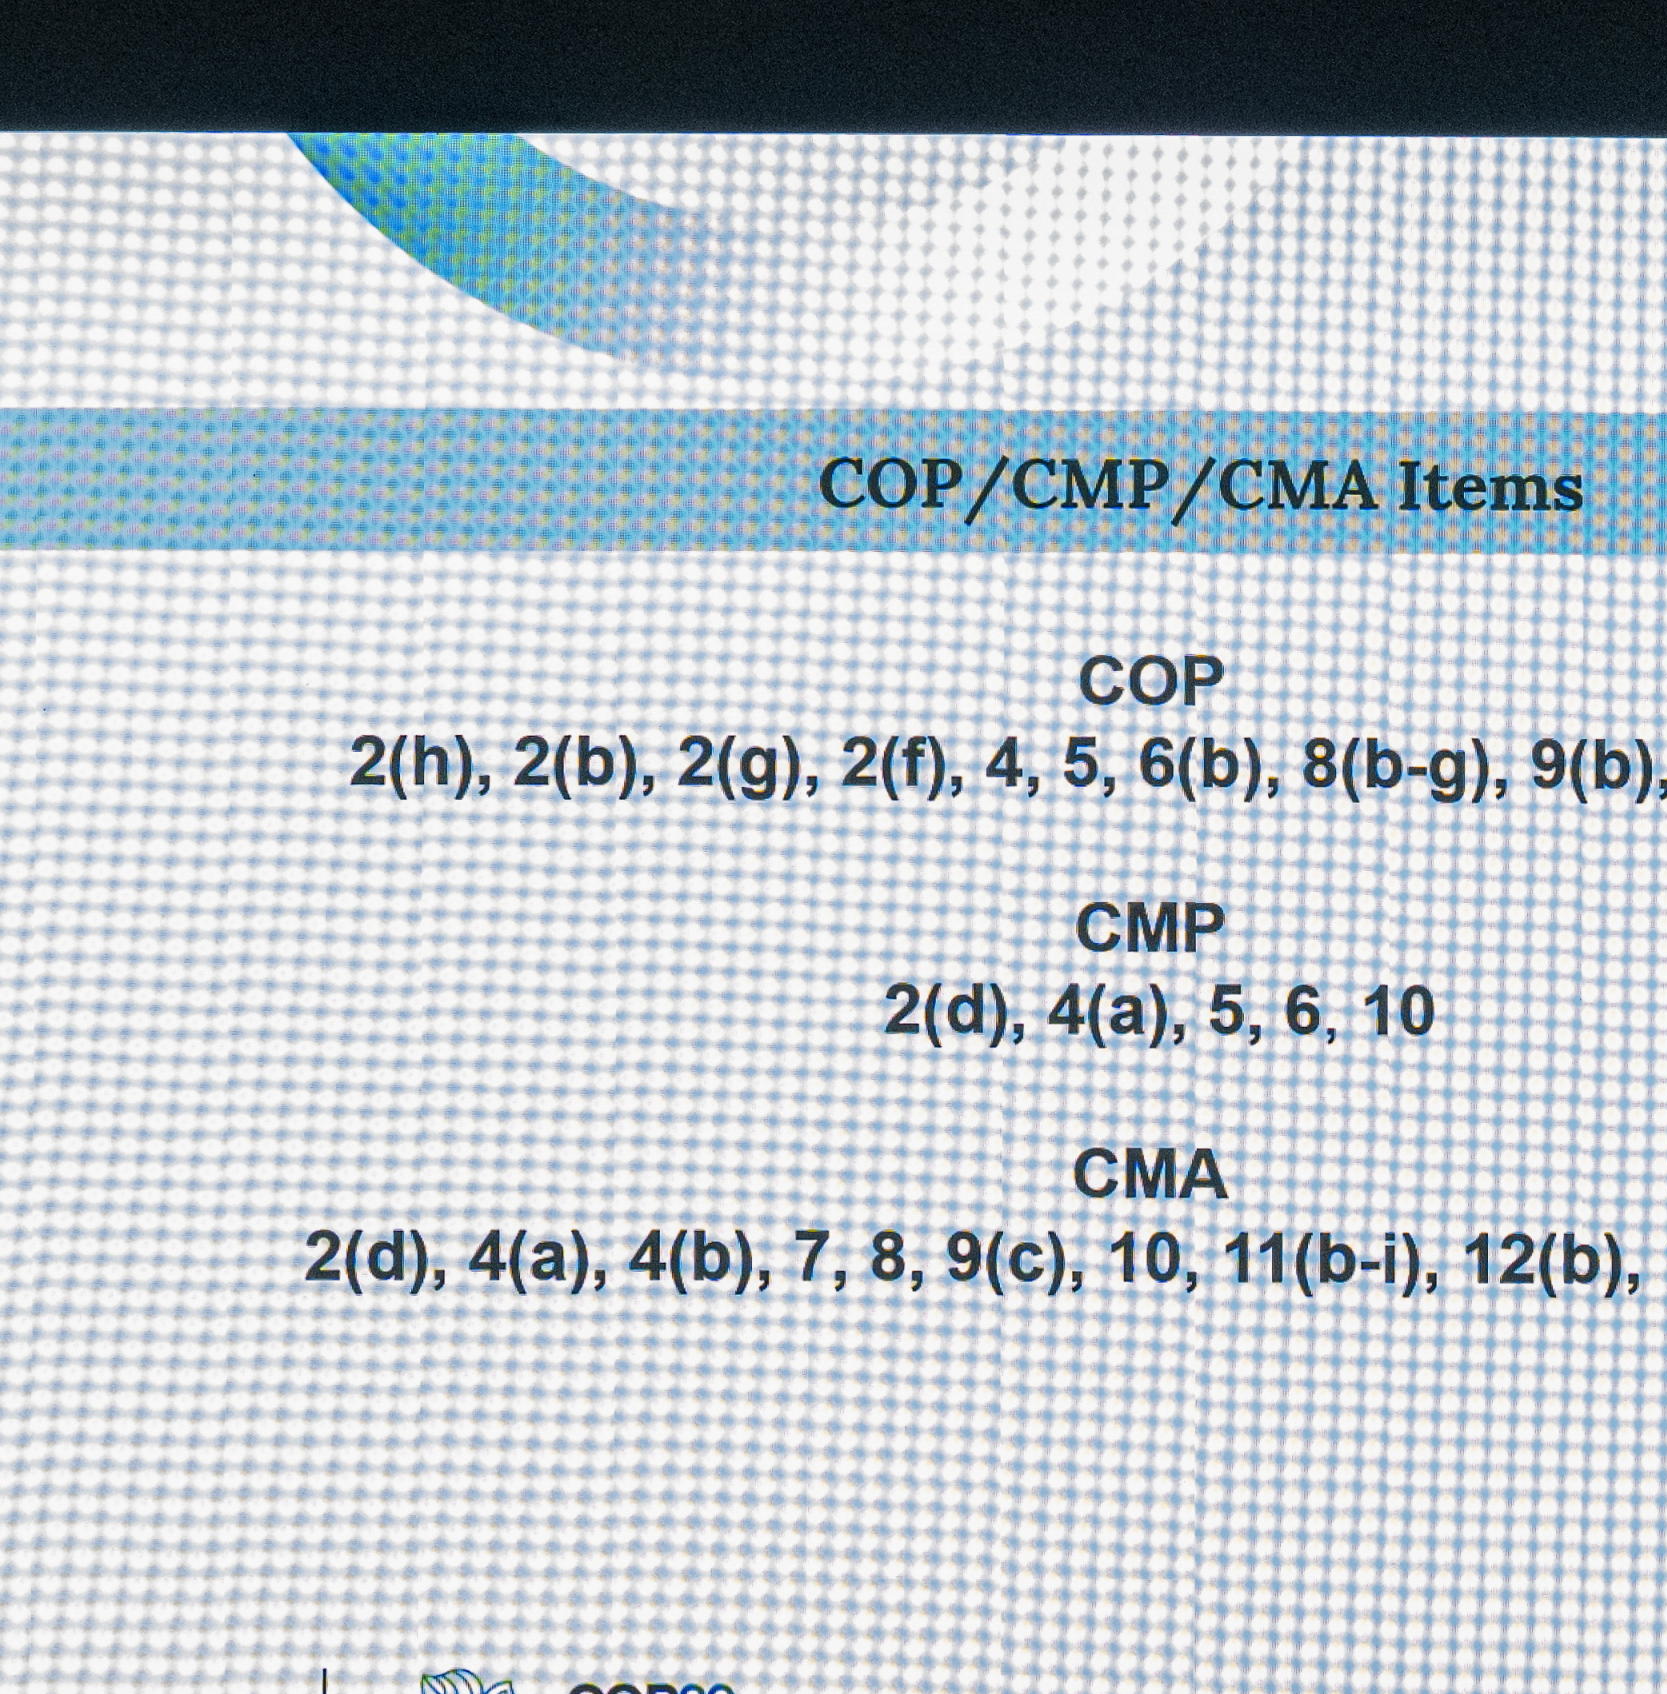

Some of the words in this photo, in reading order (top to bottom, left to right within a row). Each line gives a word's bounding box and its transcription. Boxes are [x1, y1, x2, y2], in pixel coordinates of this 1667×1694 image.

[820, 456, 1379, 527] COP/CMP/CMA
[1399, 461, 1584, 512] Items
[1081, 655, 1223, 705] COP
[351, 735, 489, 799] 2(h),
[515, 735, 653, 799] 2(b),
[679, 736, 817, 800] 2(g),
[843, 736, 961, 800] 2(f),
[987, 737, 1038, 797] 4,
[1065, 737, 1114, 797] 5,
[1141, 737, 1278, 802] 6(b),
[1304, 738, 1506, 803] 8(b-g),
[1078, 902, 1224, 952] CMP
[886, 983, 1023, 1047] 2(d),
[1049, 984, 1184, 1048] 4(a),
[1211, 985, 1260, 1045] 5,
[1287, 985, 1334, 1044] 6,
[1366, 985, 1433, 1035] 10
[1075, 1148, 1228, 1198] CMA
[306, 1230, 445, 1294] 2(d),
[470, 1230, 605, 1294] 4(a),
[630, 1230, 769, 1294] 4(b),
[796, 1231, 845, 1291] 7,
[872, 1231, 922, 1291] 8,
[948, 1231, 1082, 1296] 9(c),
[1112, 1232, 1196, 1292] 10,
[1226, 1233, 1437, 1297] 11(b-i),
[1466, 1233, 1638, 1298] 12(b),
